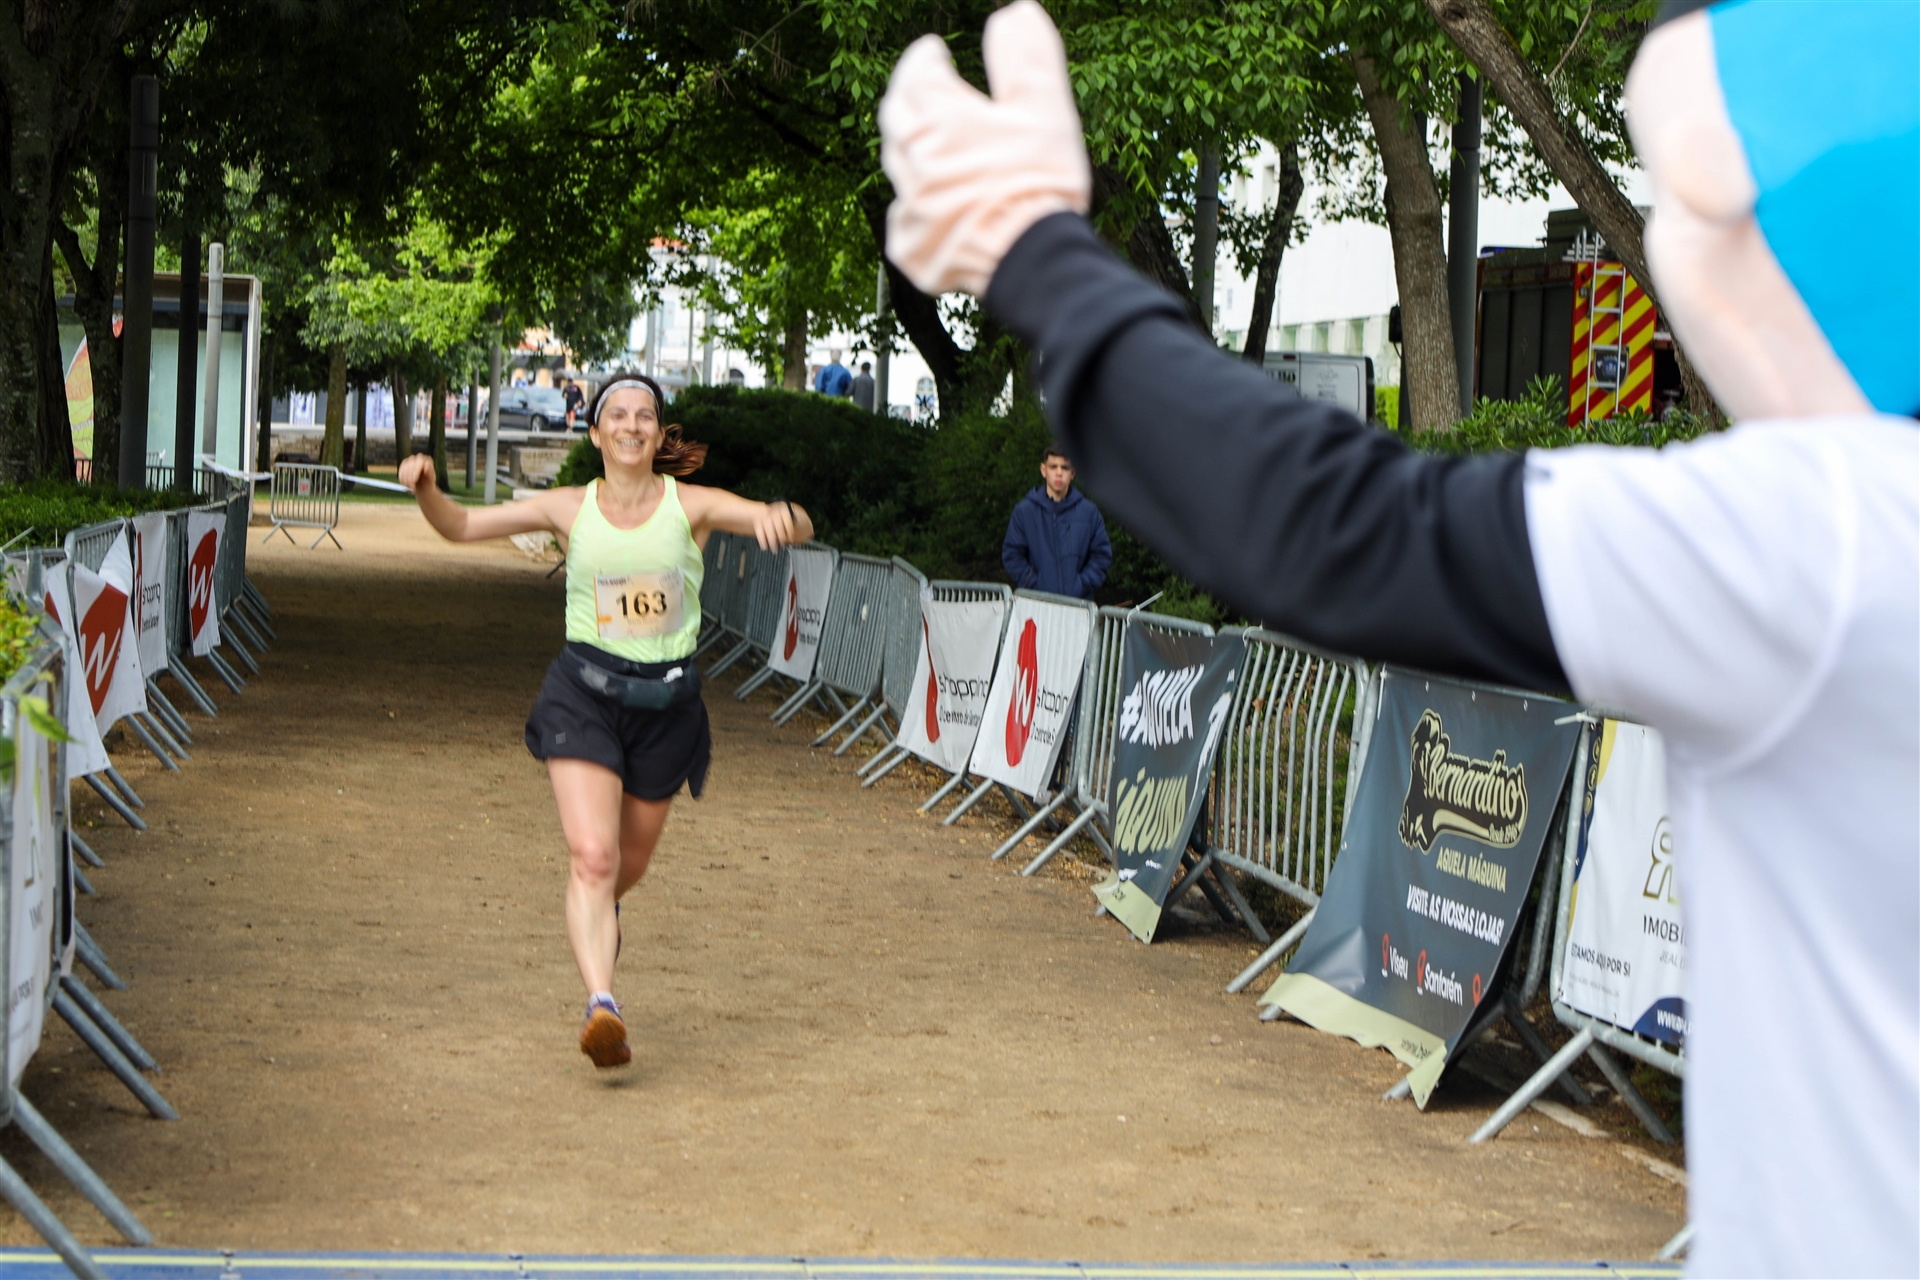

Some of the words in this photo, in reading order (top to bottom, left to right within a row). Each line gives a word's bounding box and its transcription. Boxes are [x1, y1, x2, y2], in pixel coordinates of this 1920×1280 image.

[616, 590, 667, 617] 163
[1428, 742, 1521, 821] Bernardino
[1436, 846, 1467, 879] AQUELA
[1467, 852, 1507, 893] MÁQUINA
[1429, 893, 1441, 921] AS
[1441, 897, 1475, 935] NOSSAS
[1390, 945, 1409, 980] Viseu
[1425, 962, 1463, 1006] Santarém
[1607, 957, 1622, 976] POR
